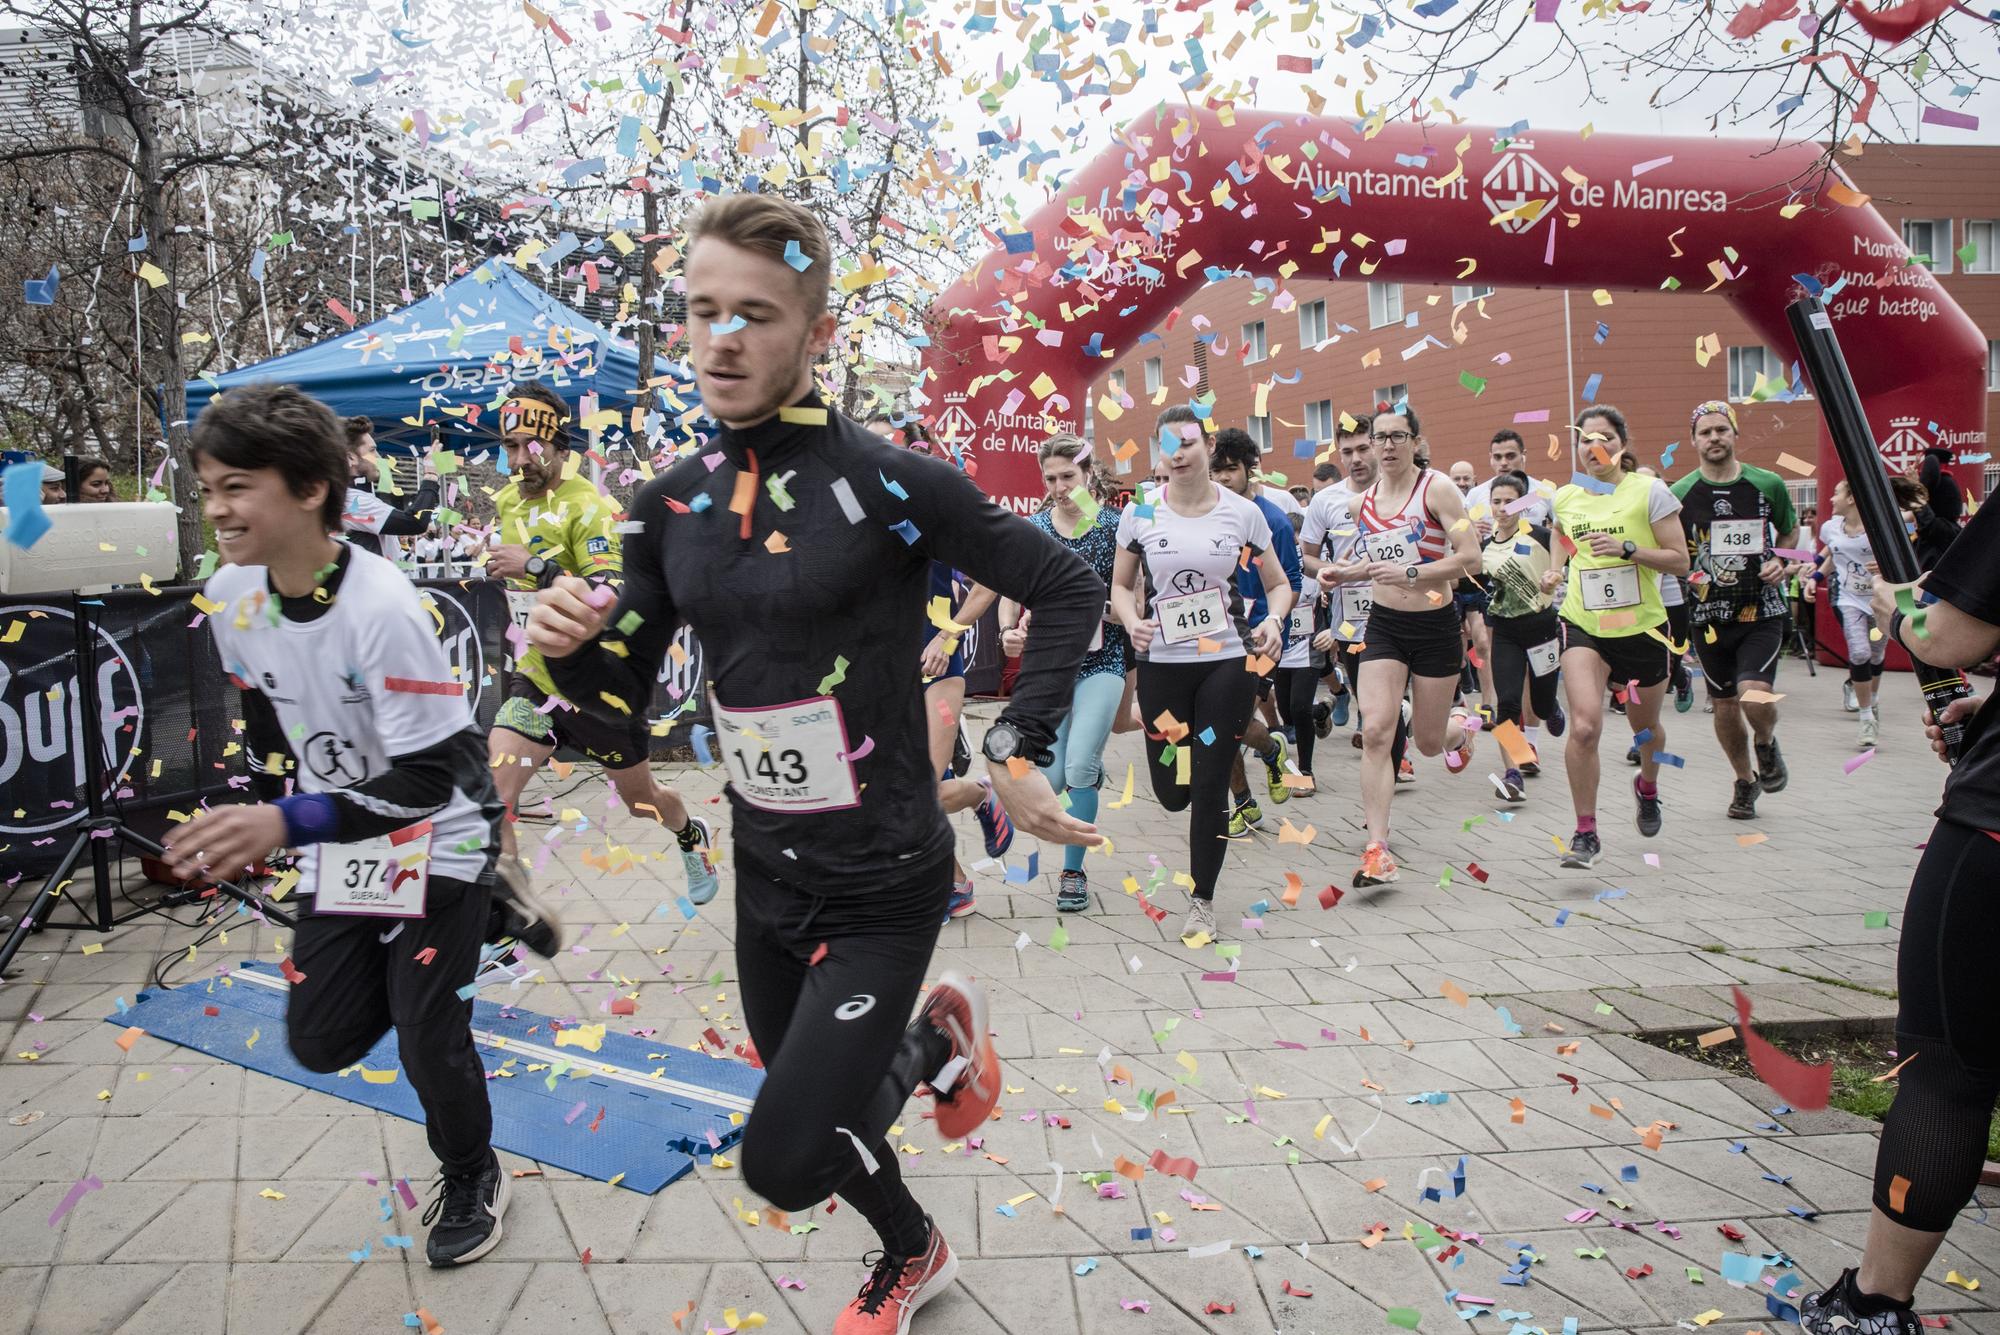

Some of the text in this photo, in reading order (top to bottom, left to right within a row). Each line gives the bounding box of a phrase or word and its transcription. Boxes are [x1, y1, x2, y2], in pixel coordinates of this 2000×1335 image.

[1293, 161, 1728, 213] Ajuntament de Manresa
[1831, 294, 1940, 323] que batega
[982, 432, 1006, 452] de
[1723, 533, 1751, 546] 438
[1377, 543, 1404, 561] 226
[1604, 583, 1615, 598] 6
[1176, 608, 1211, 629] 418
[1547, 652, 1556, 664] 9
[733, 749, 808, 785] 143
